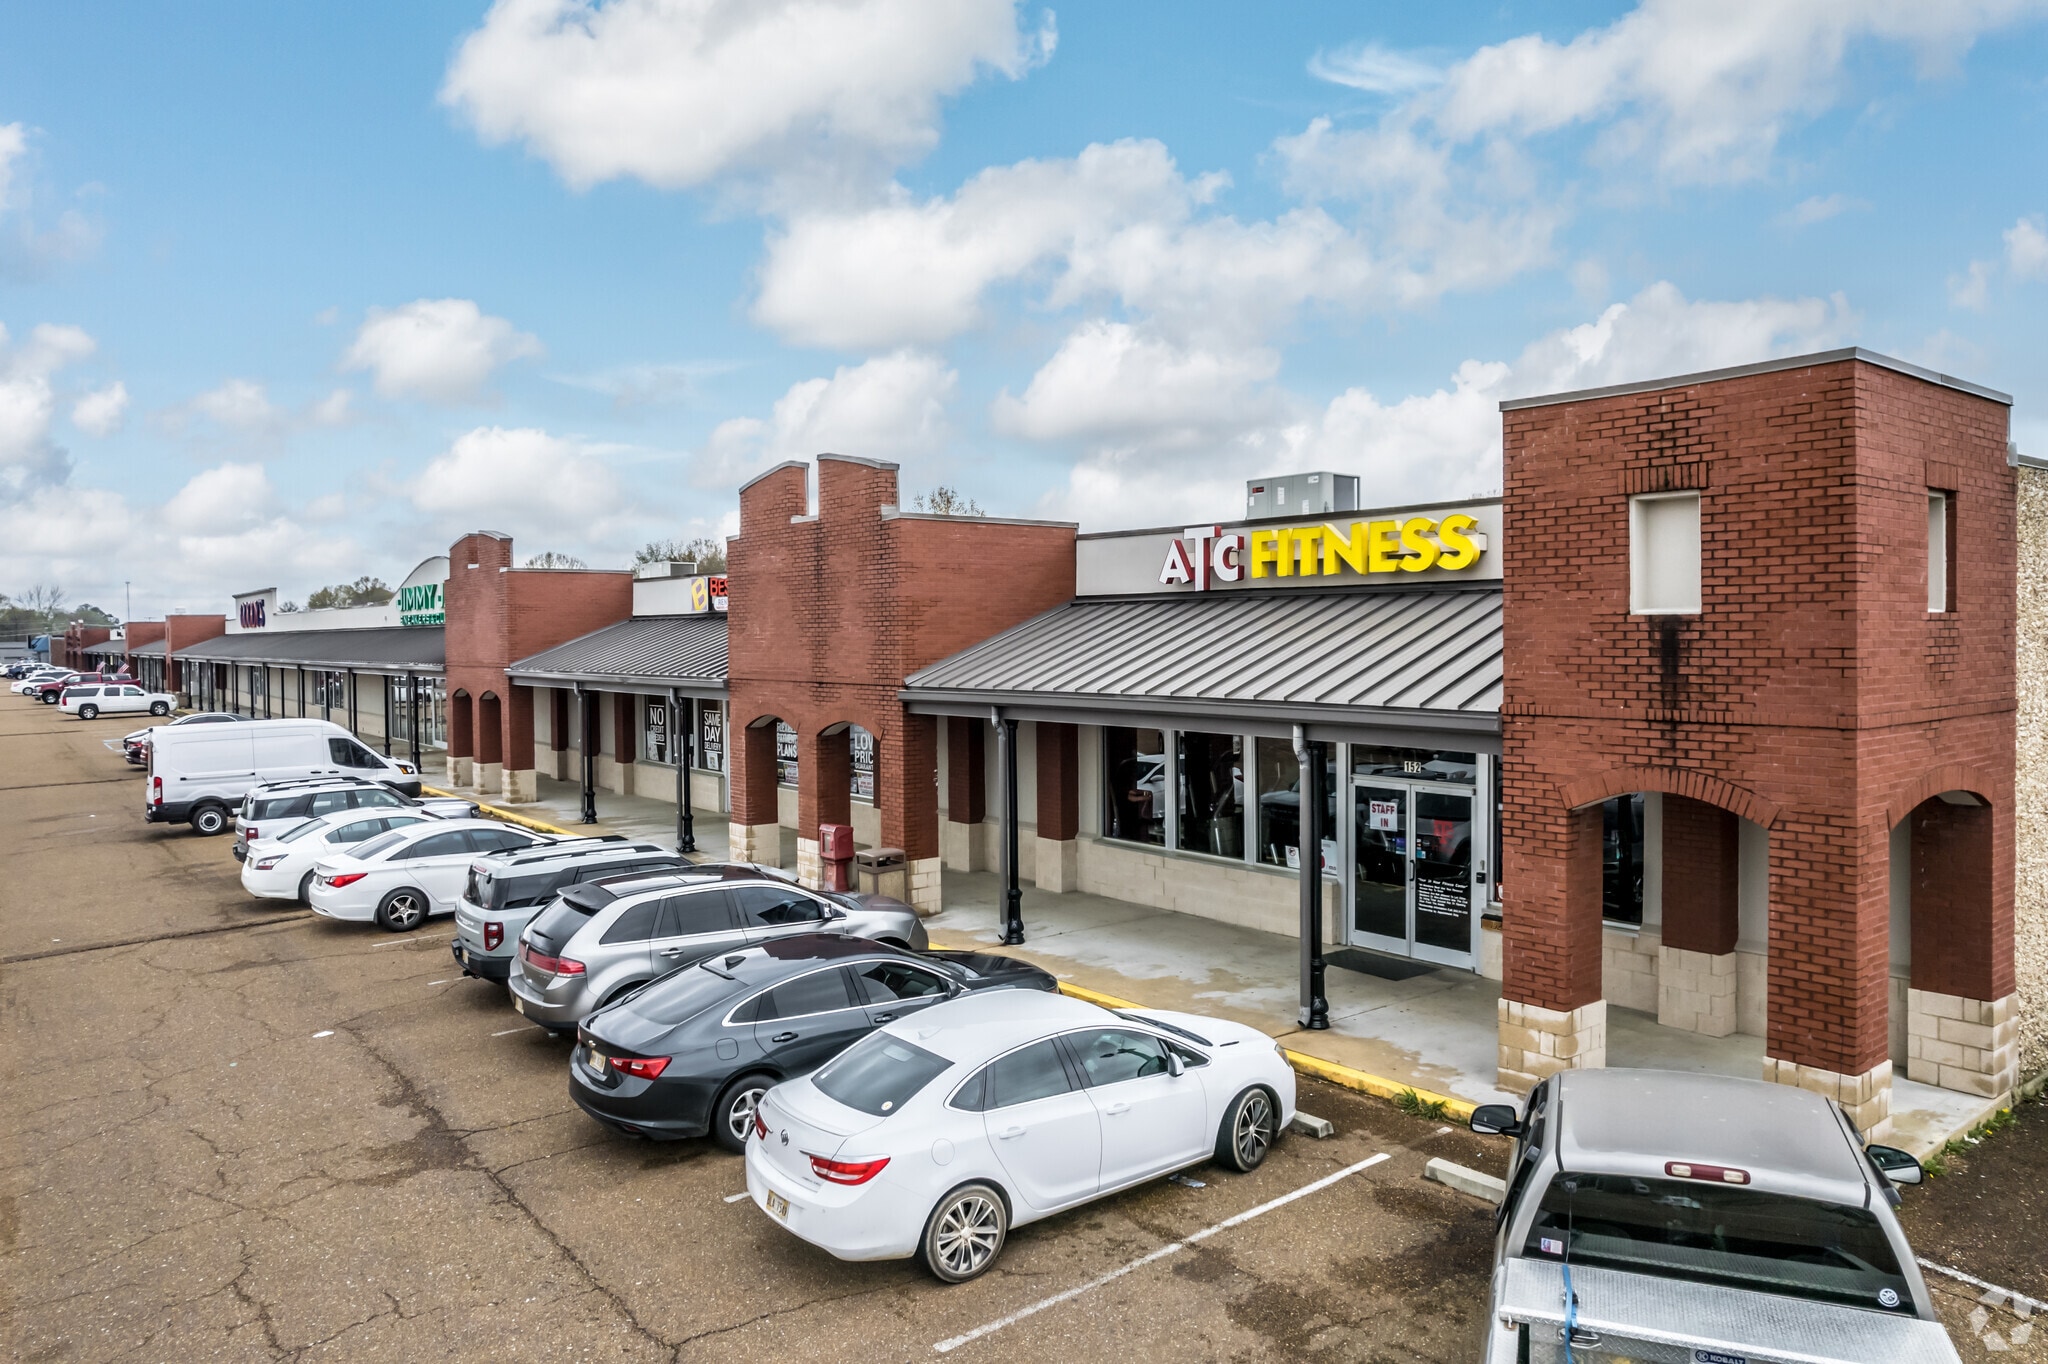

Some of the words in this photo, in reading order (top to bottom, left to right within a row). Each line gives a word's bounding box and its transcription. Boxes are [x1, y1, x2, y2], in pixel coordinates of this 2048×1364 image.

[1158, 526, 1244, 592] ATC
[1251, 513, 1480, 579] FITNESS
[396, 584, 438, 611] JIMMY
[649, 707, 664, 725] NO
[704, 712, 721, 726] SAME
[704, 726, 721, 742] DAY
[704, 741, 721, 751] DELIVERY
[777, 743, 798, 759] PLANS
[854, 750, 873, 765] PRIC
[1405, 761, 1421, 773] 152
[1371, 803, 1396, 815] STAFF
[1380, 818, 1389, 828] IN
[1710, 1355, 1744, 1364] KOBALT
